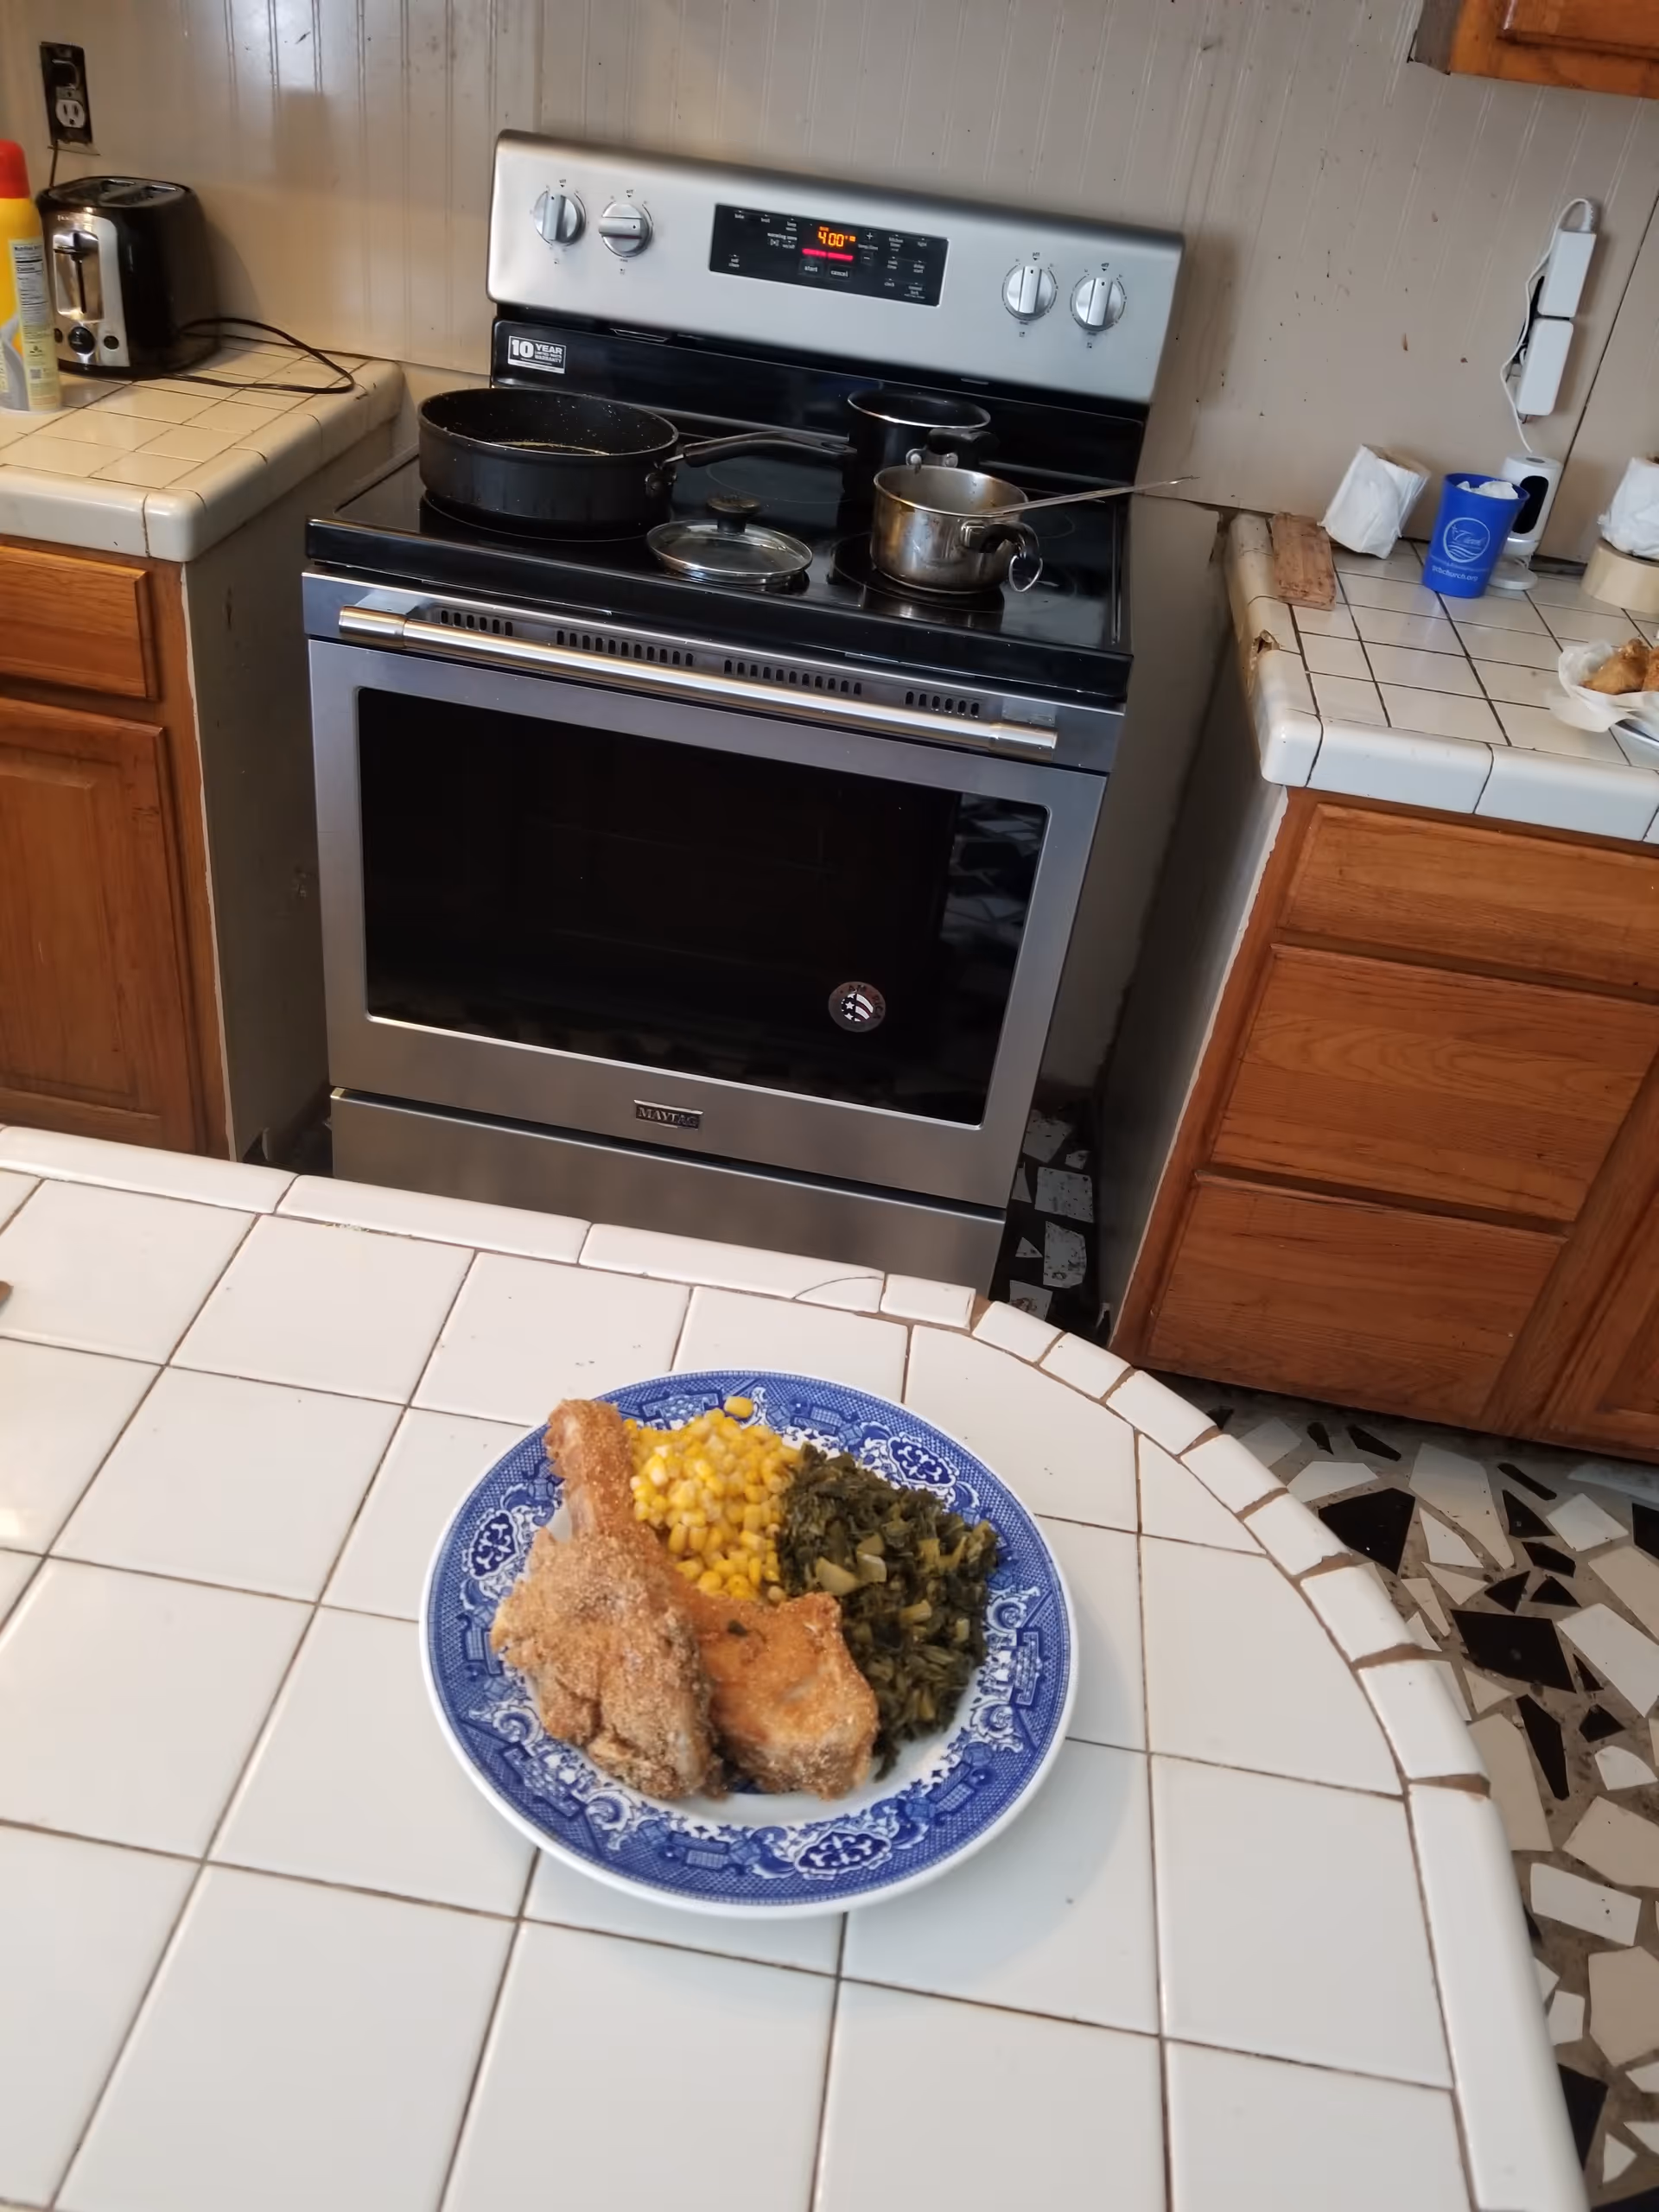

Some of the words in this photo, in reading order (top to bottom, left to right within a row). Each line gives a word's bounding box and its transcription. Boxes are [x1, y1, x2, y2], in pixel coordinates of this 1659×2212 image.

[804, 264, 818, 273] start
[512, 339, 534, 358] 10
[535, 343, 563, 355] YEAR
[638, 1107, 696, 1126] MAYTAG
